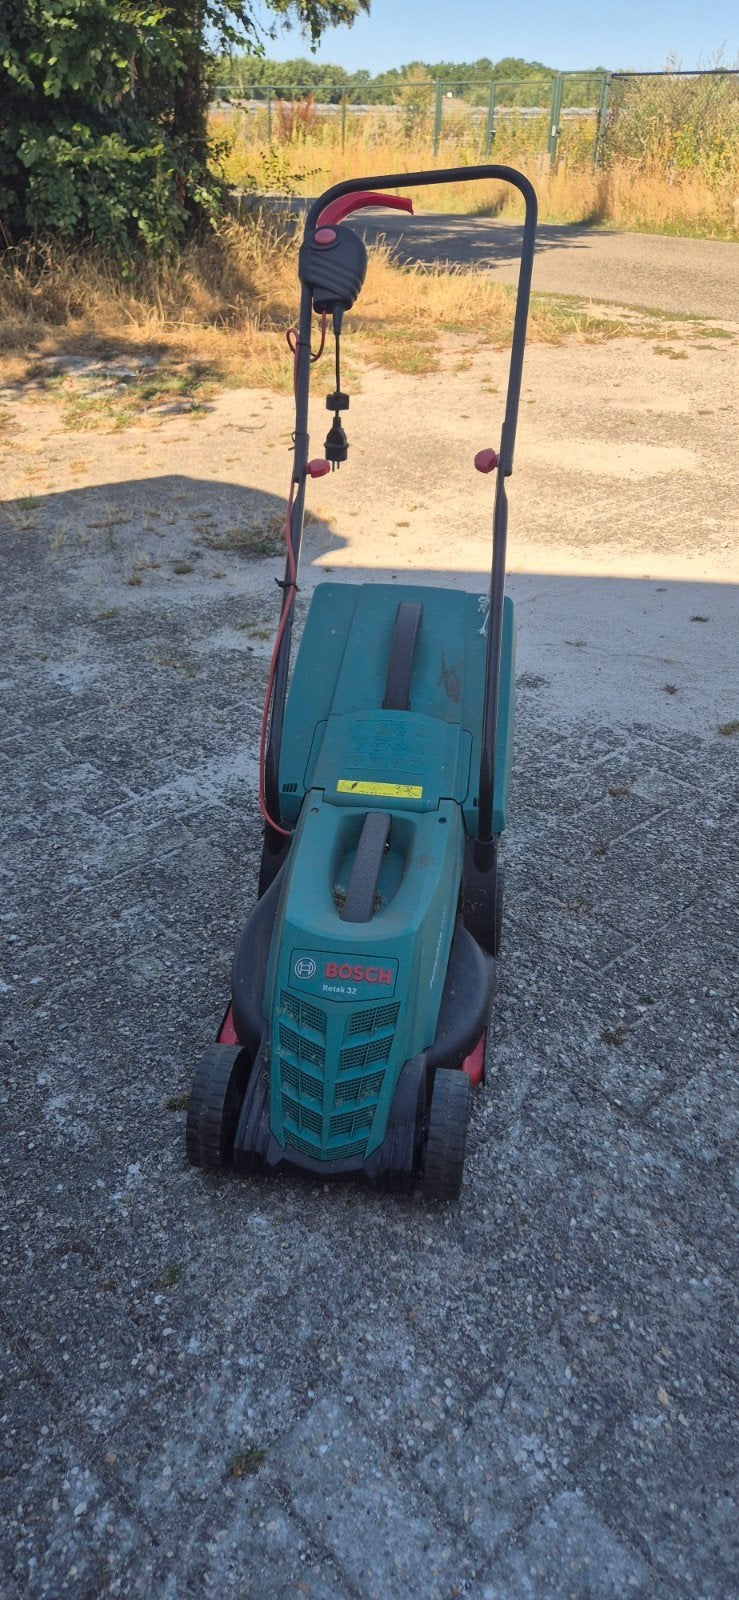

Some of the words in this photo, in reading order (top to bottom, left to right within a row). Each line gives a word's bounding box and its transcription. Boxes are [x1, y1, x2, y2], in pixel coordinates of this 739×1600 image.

[325, 962, 392, 985] BOSCH
[322, 984, 345, 994] Rotak
[346, 986, 357, 995] 32
